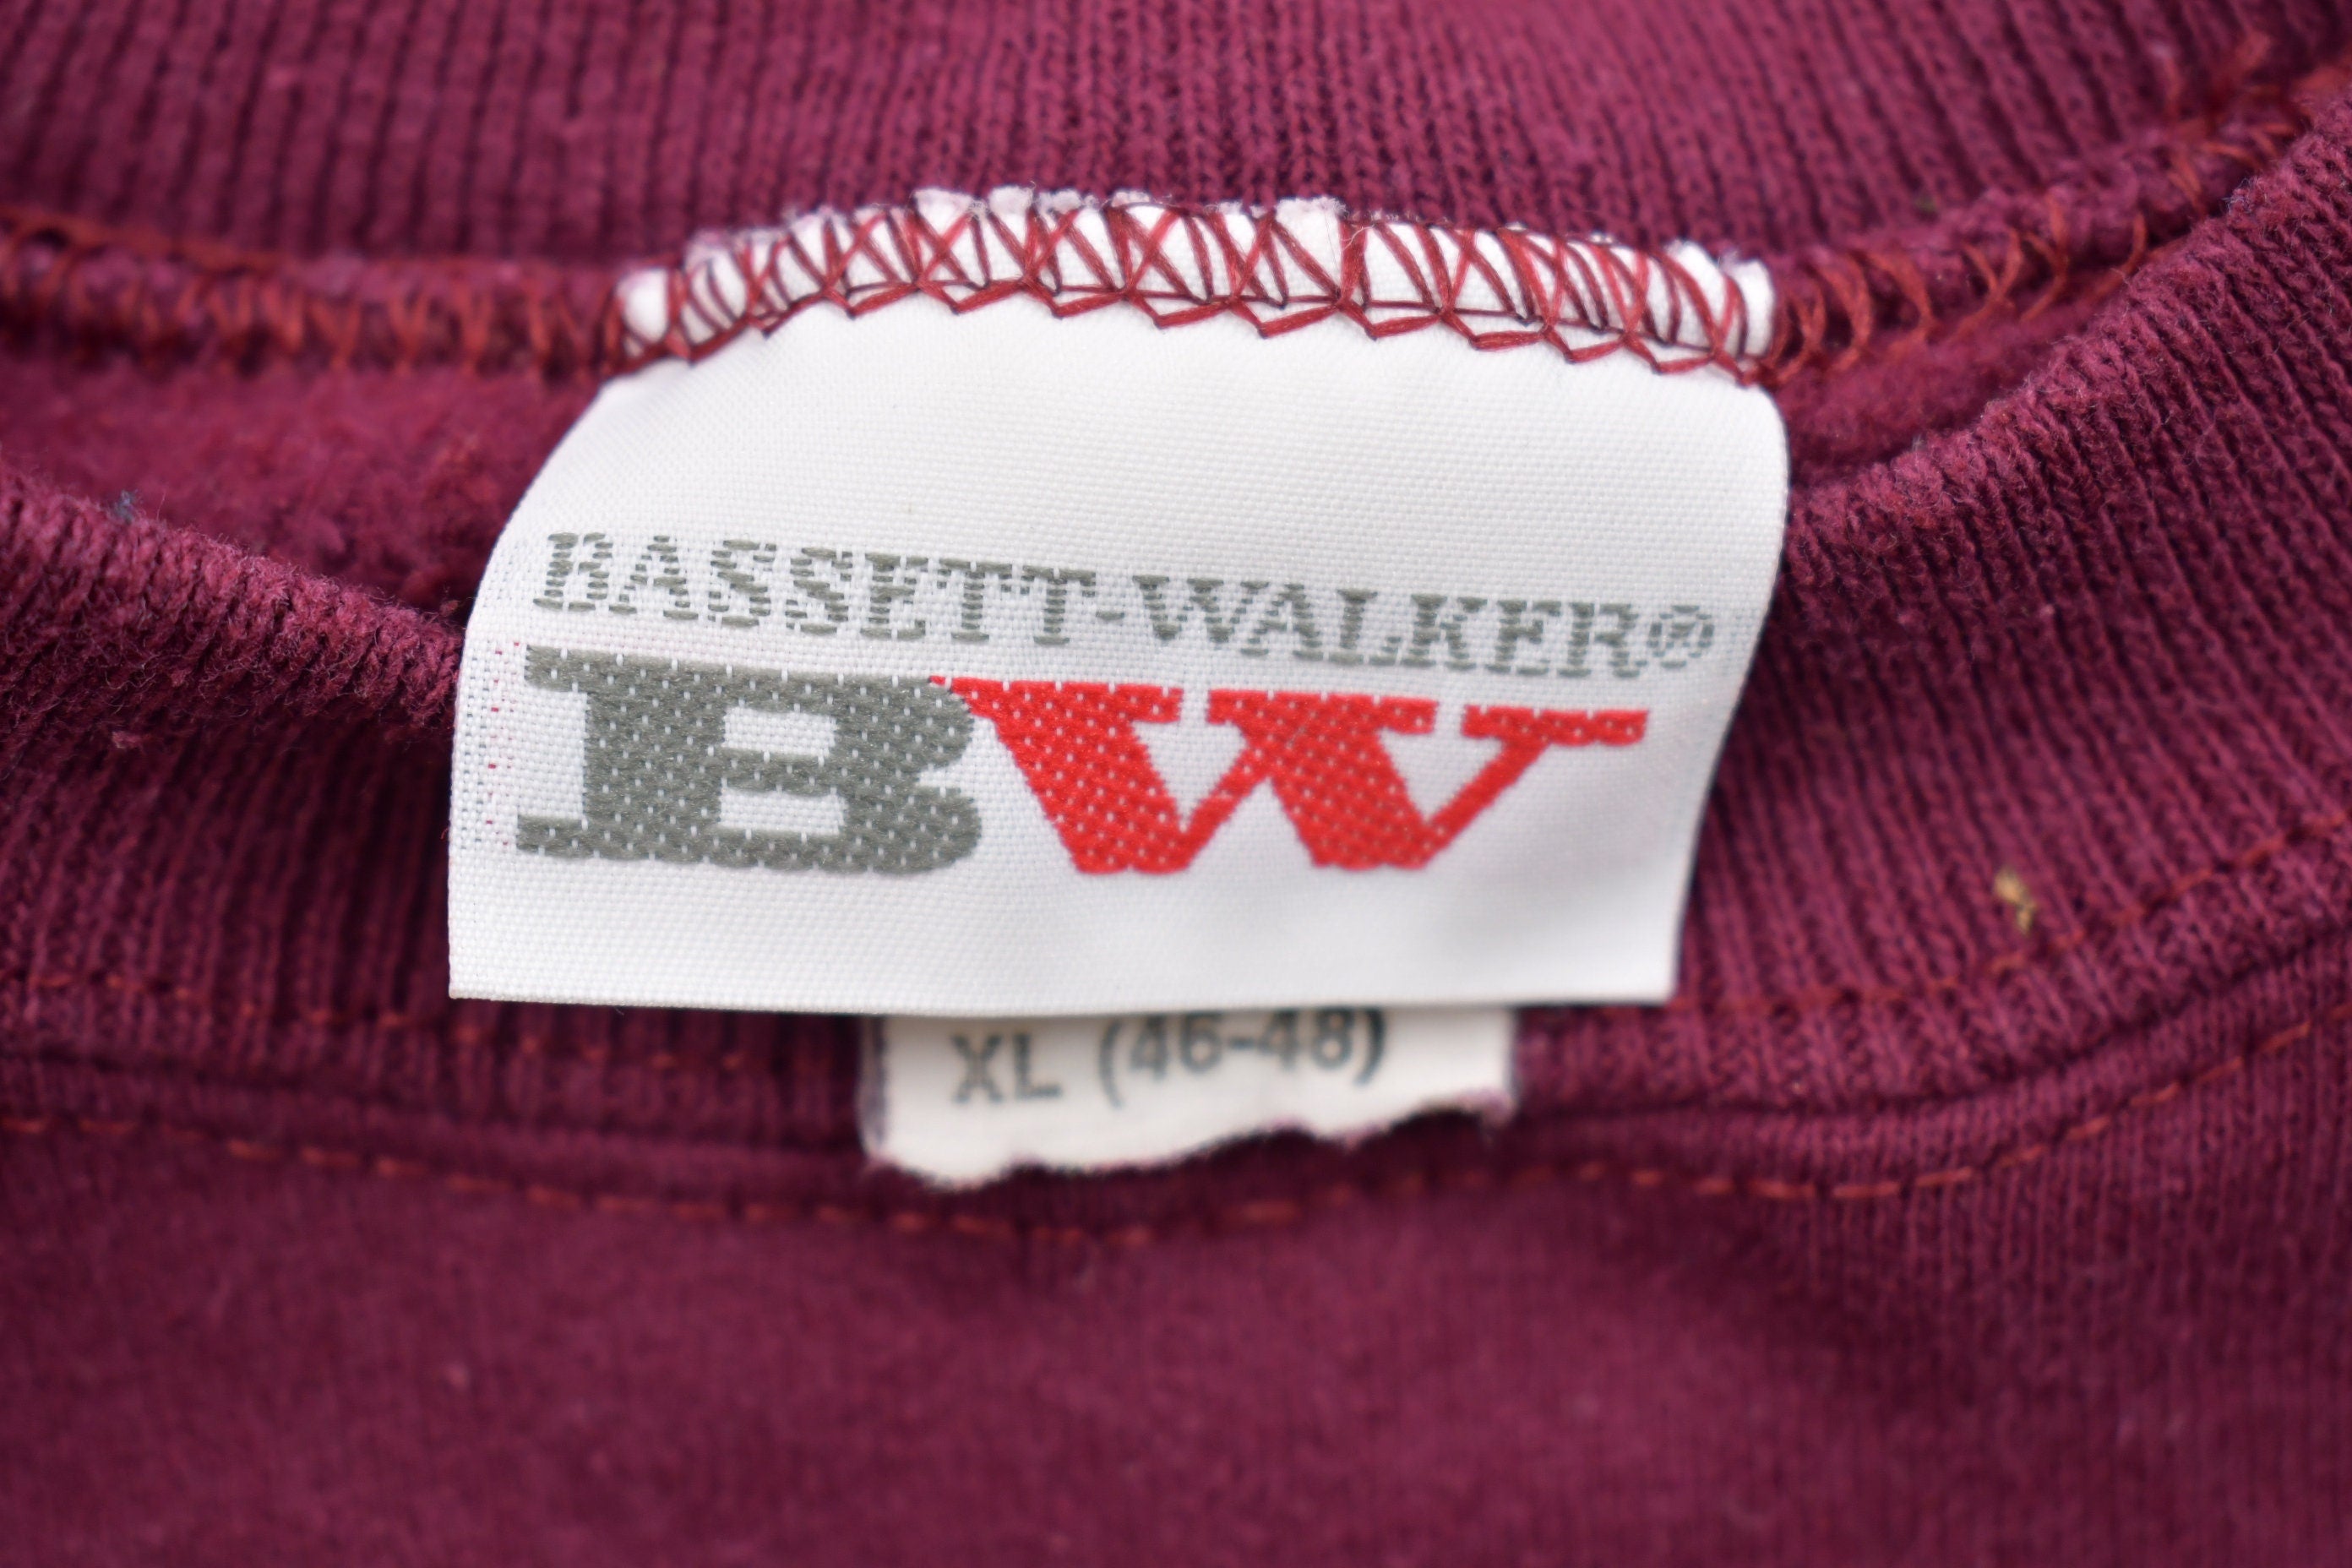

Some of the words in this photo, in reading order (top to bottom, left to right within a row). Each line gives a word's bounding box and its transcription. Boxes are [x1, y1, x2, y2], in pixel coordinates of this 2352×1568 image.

[516, 645, 1648, 875] BW
[949, 1033, 1063, 1105] XL
[1098, 1007, 1387, 1108] (46-48)
